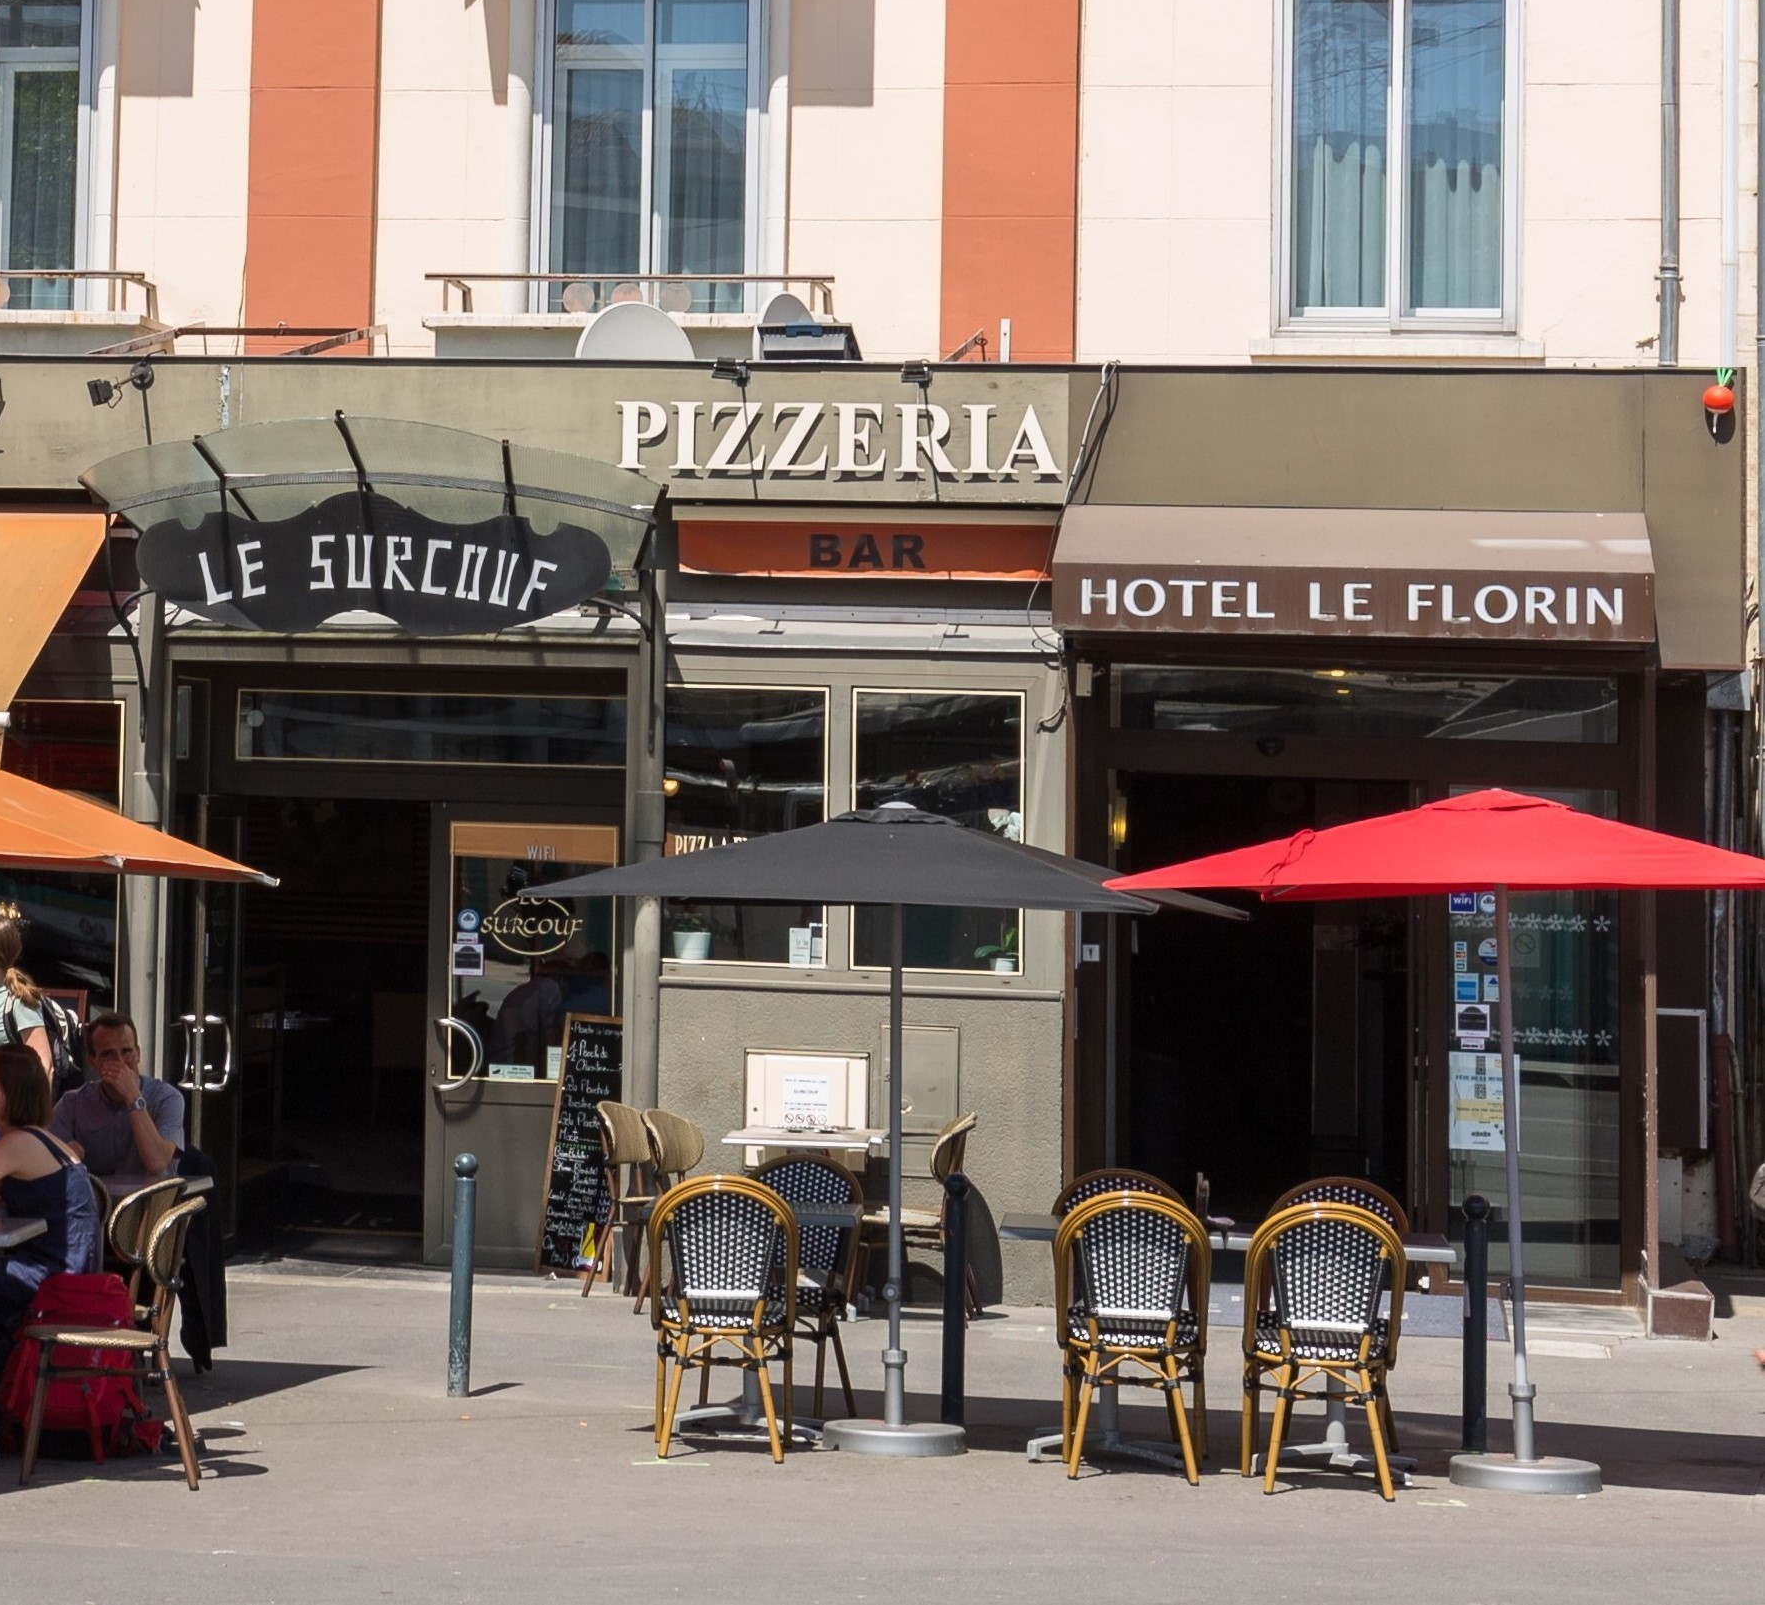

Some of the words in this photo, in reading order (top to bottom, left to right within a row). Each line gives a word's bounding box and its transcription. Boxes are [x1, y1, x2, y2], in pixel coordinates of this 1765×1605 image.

[615, 400, 1062, 475] PIZZERIA
[198, 540, 266, 606] LE
[309, 534, 558, 611] SURCOUF
[810, 533, 926, 569] BAR
[1081, 578, 1275, 619] HOTEL
[1309, 582, 1373, 622] LE
[1407, 584, 1624, 626] FLORIN
[481, 915, 583, 943] SURCOUF
